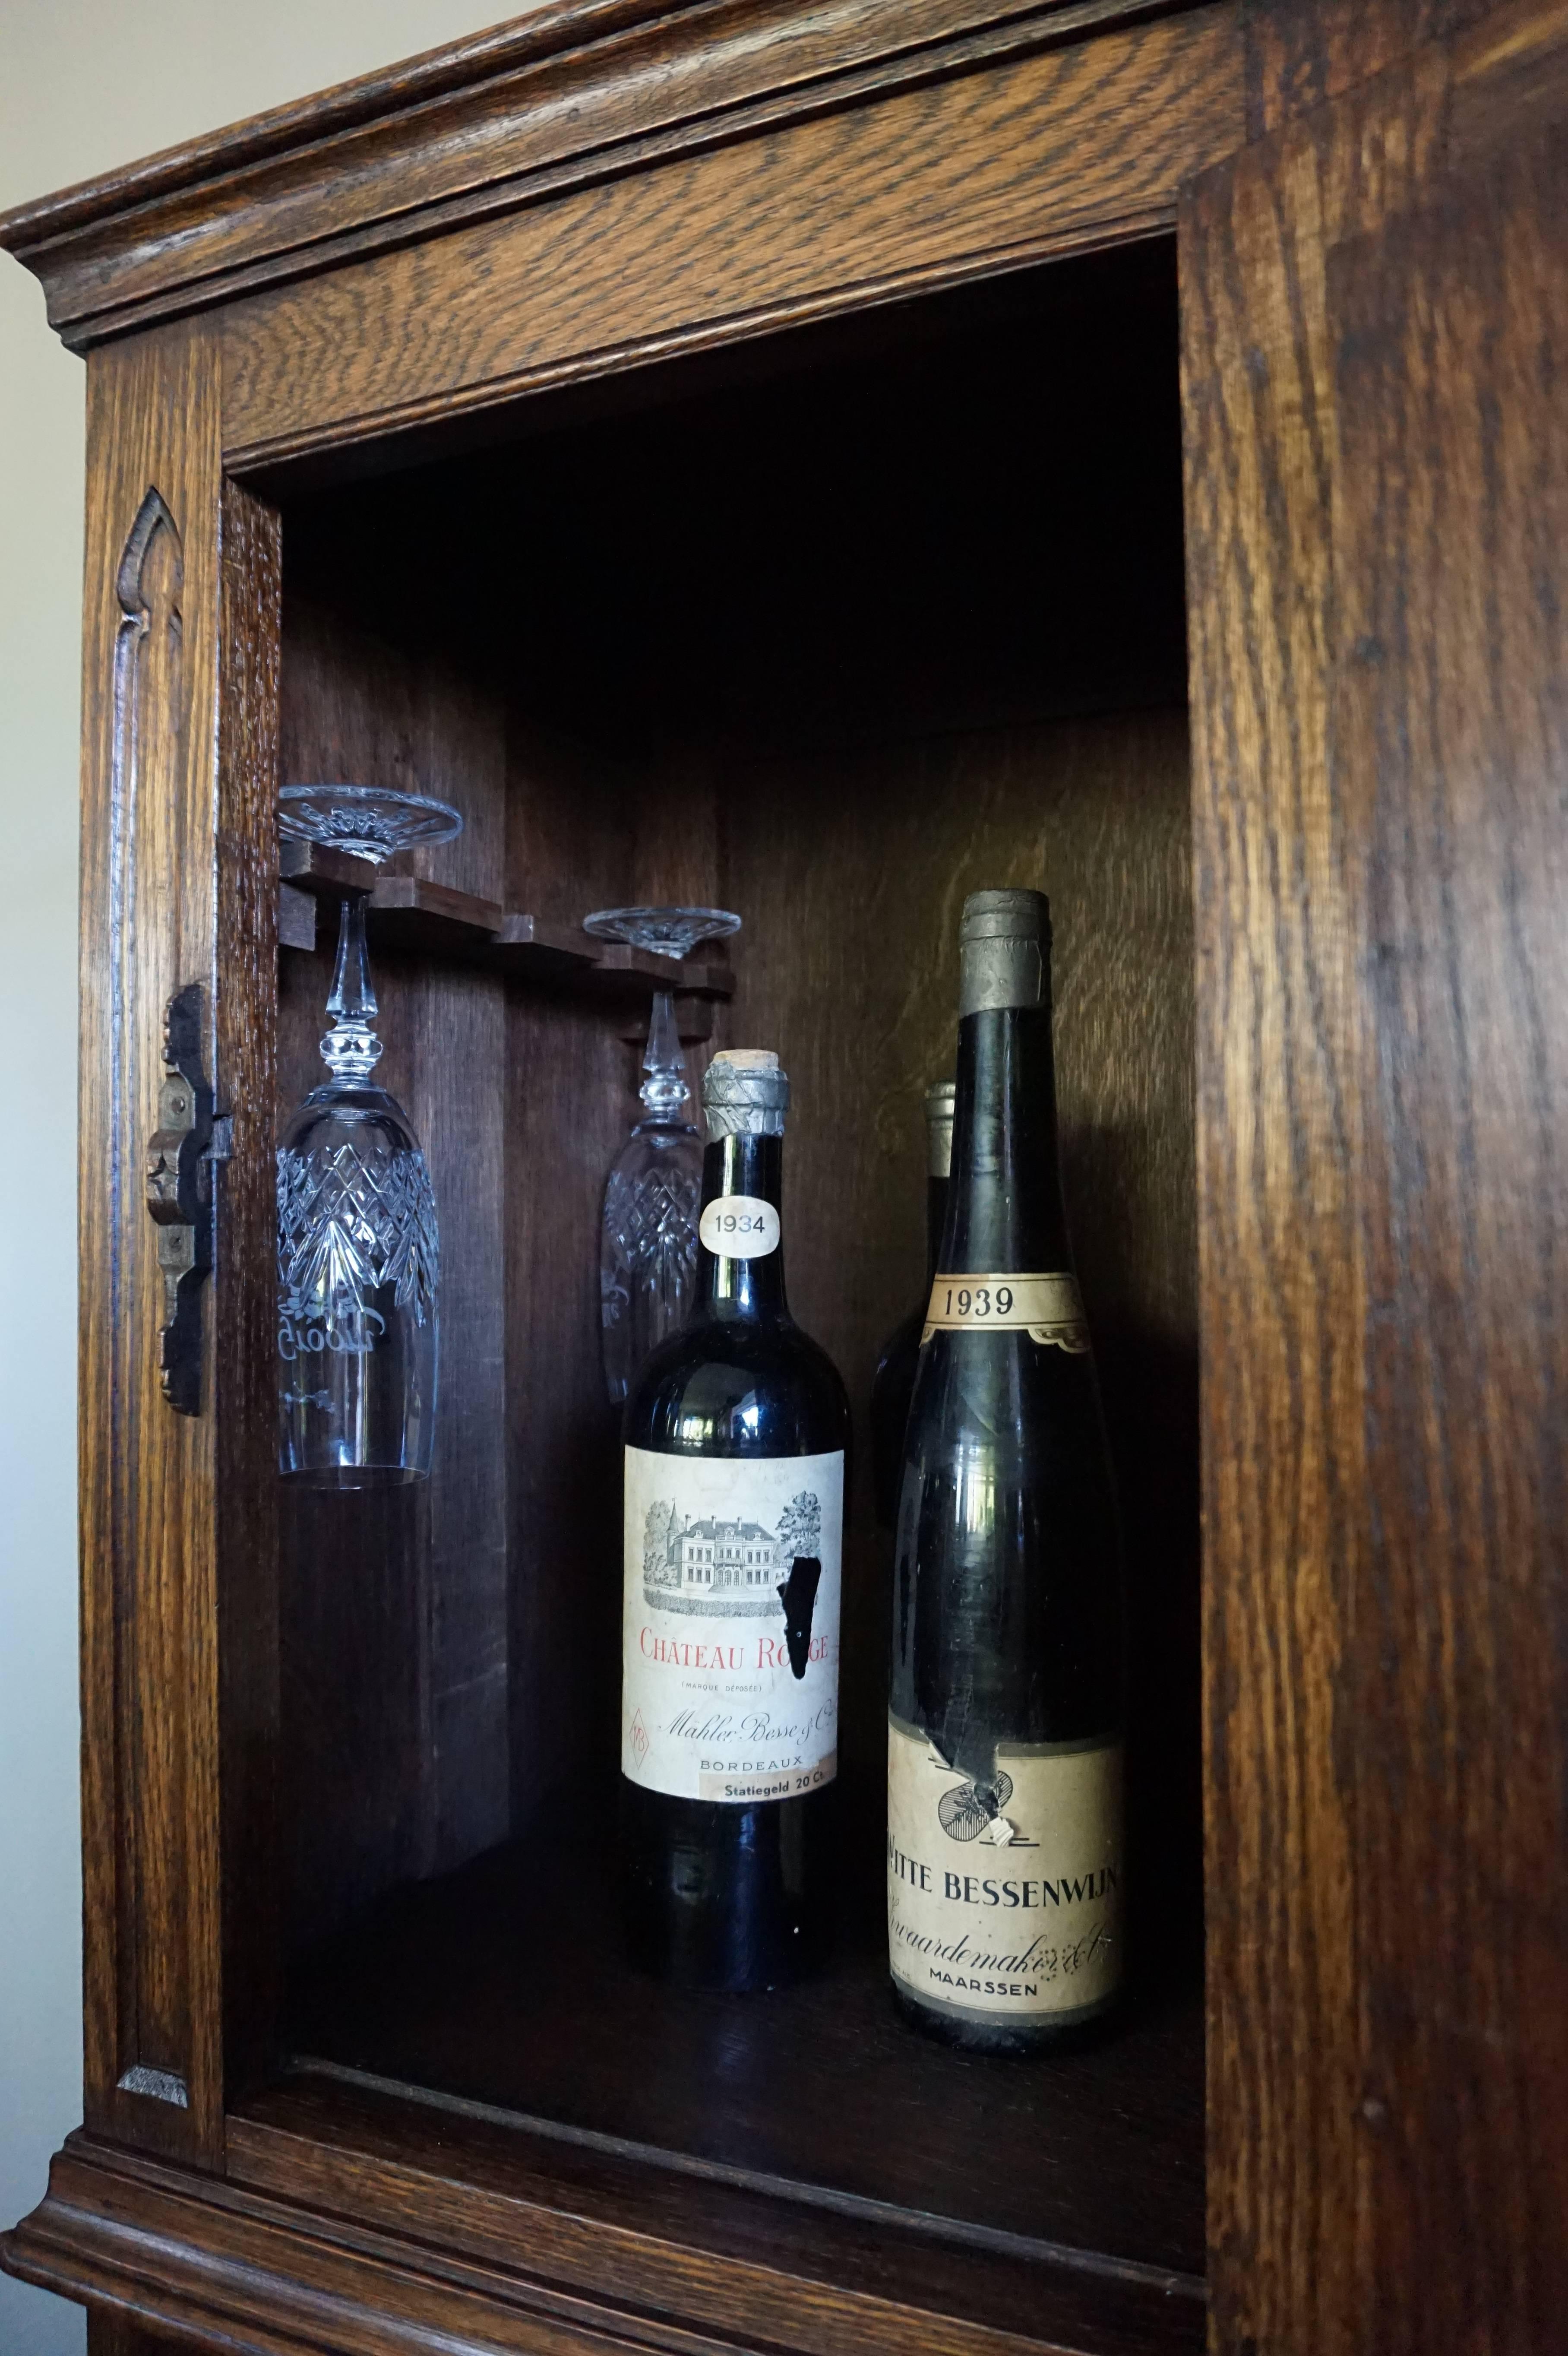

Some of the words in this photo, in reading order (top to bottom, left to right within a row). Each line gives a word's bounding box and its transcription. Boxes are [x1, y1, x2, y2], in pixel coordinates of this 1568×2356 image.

[715, 1215, 765, 1233] 1934
[945, 1287, 1013, 1316] 1939
[640, 1627, 744, 1670] CHÂTEAU
[756, 1635, 828, 1669] ROGE
[681, 1681, 719, 1691] (MARQUE
[738, 1712, 797, 1742] Besse
[797, 1717, 813, 1745] &
[701, 1755, 803, 1771] BORDEAUX
[724, 1780, 789, 1797] Statiegeld
[796, 1776, 810, 1789] 20
[929, 1967, 1037, 1996] MAARSSEN
